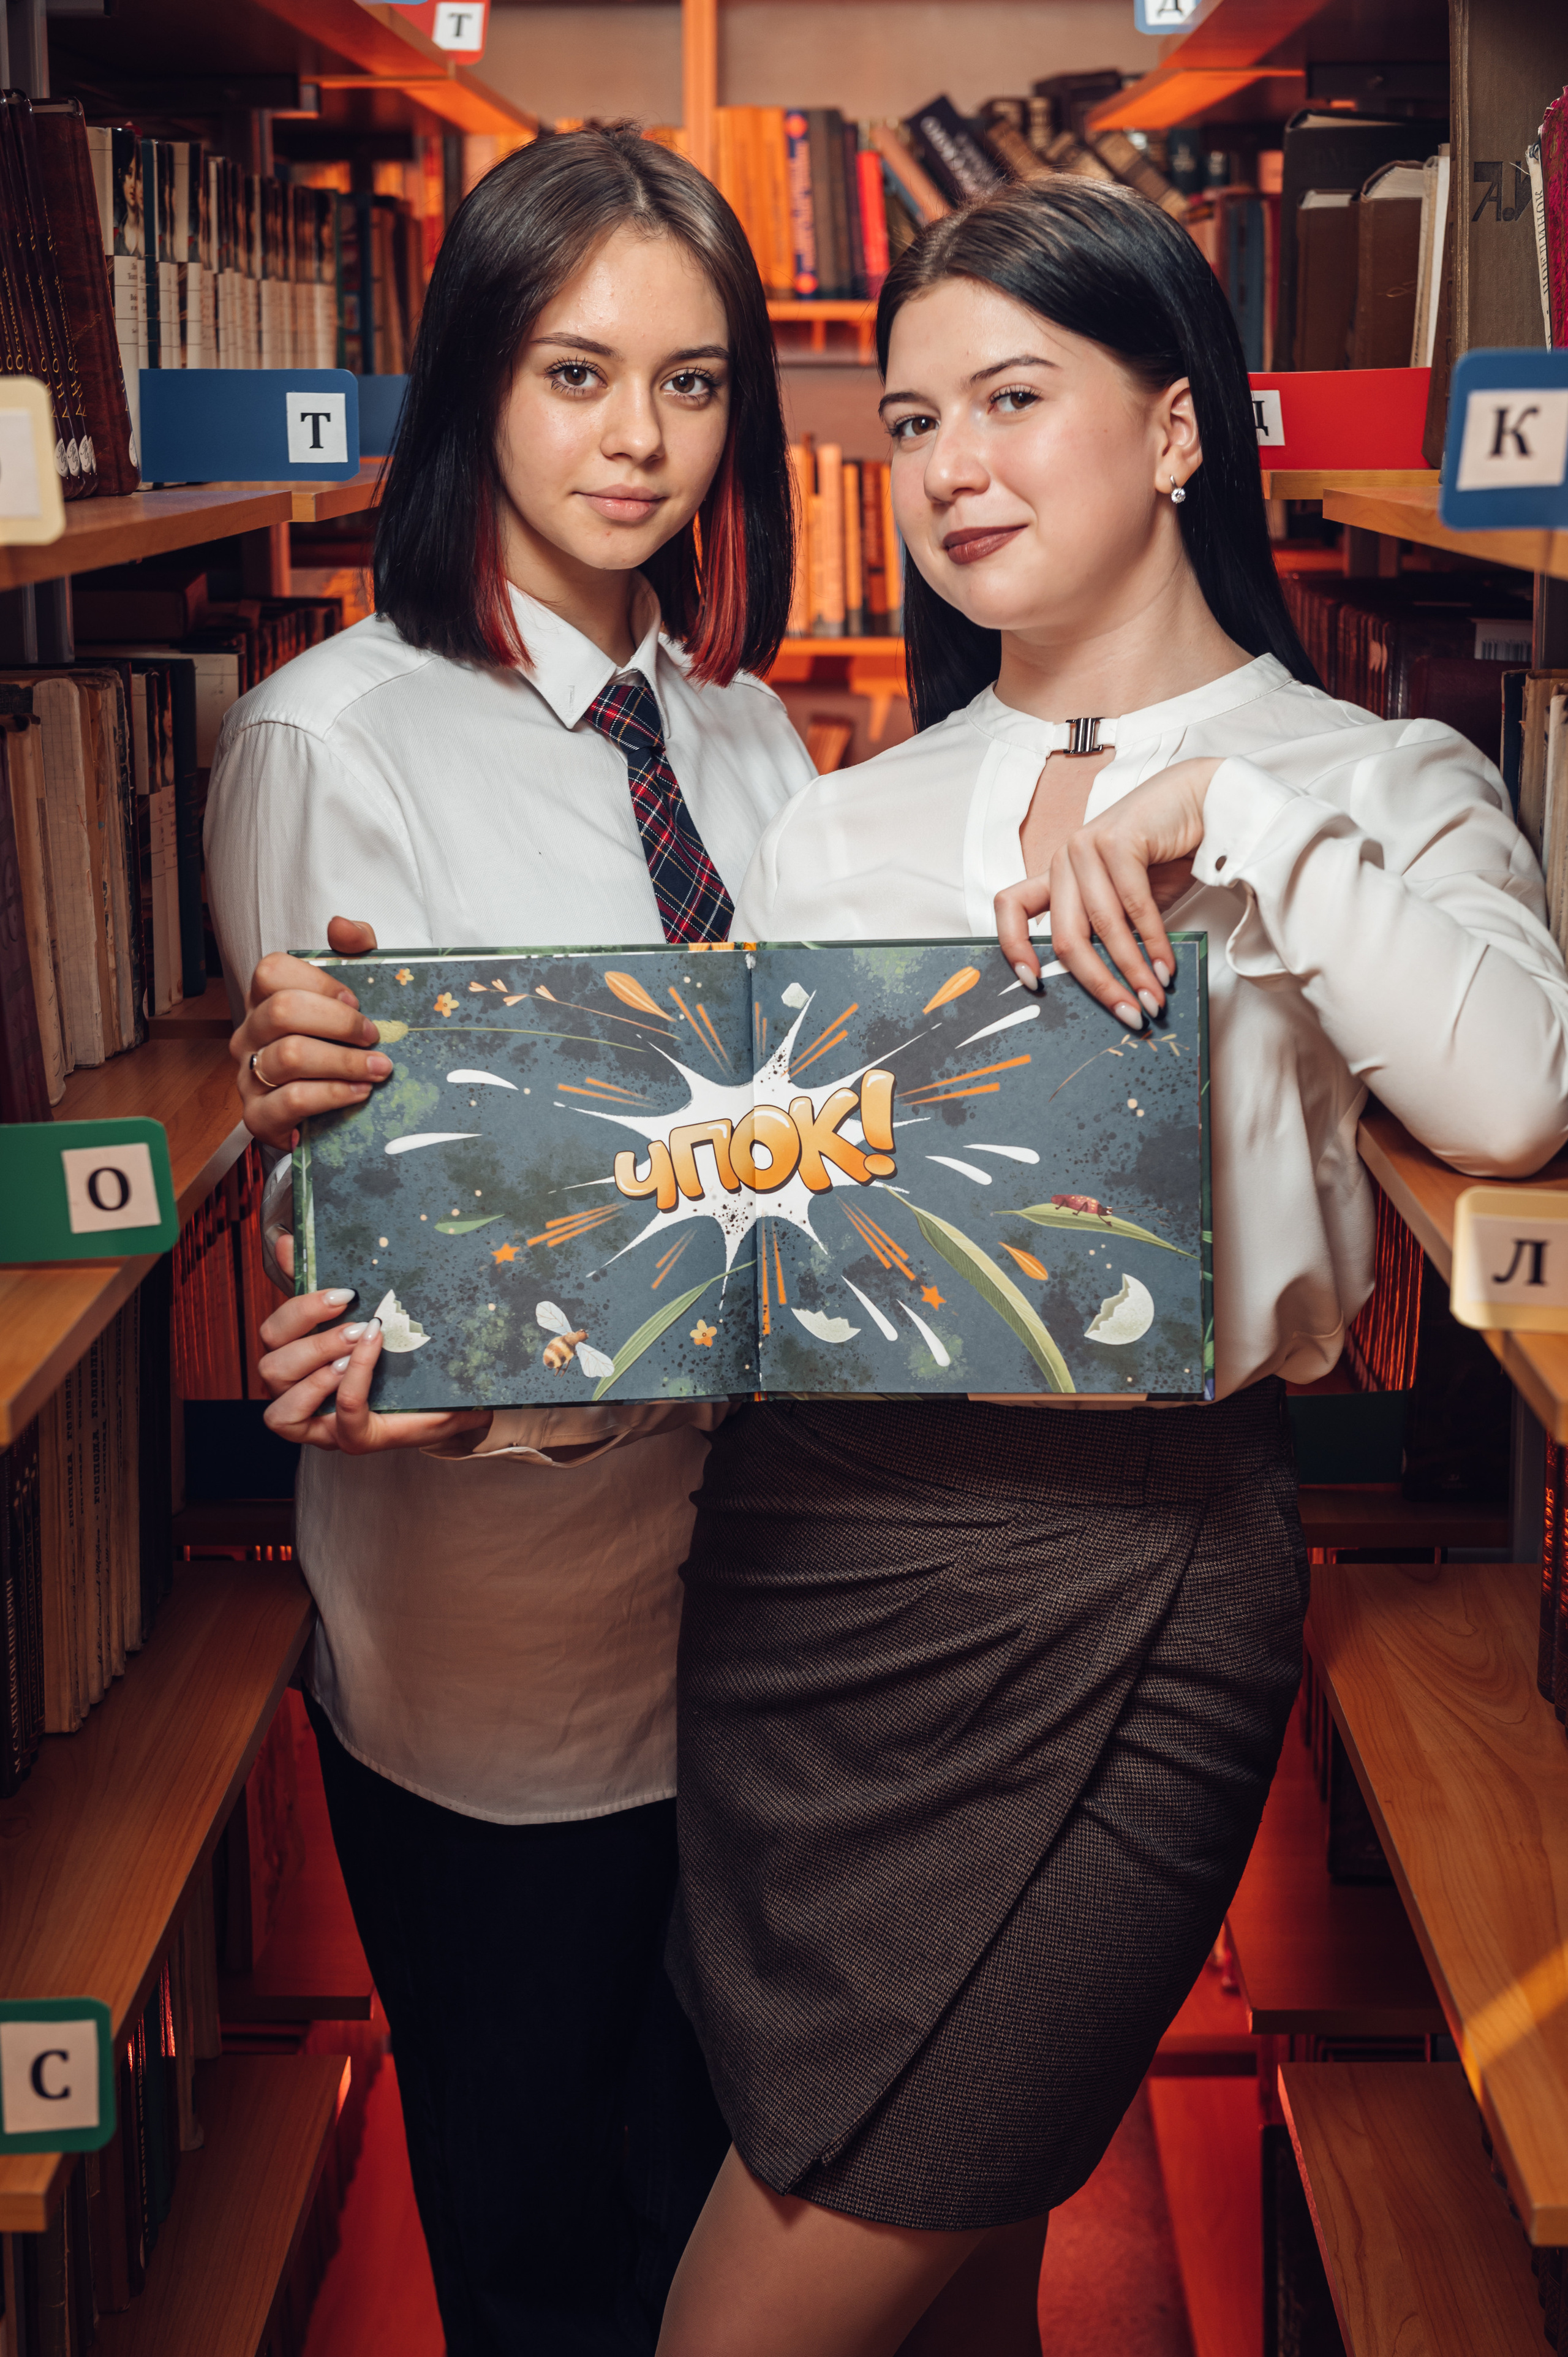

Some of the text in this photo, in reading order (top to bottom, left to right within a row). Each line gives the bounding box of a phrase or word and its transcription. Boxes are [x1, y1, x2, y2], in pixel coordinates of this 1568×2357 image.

[447, 12, 473, 38] Т
[300, 412, 331, 450] Т
[1490, 405, 1540, 458] К
[614, 1068, 897, 1213] ЧПОК!
[88, 1167, 131, 1211] О
[1493, 1238, 1549, 1287] Л
[31, 2049, 72, 2100] С
